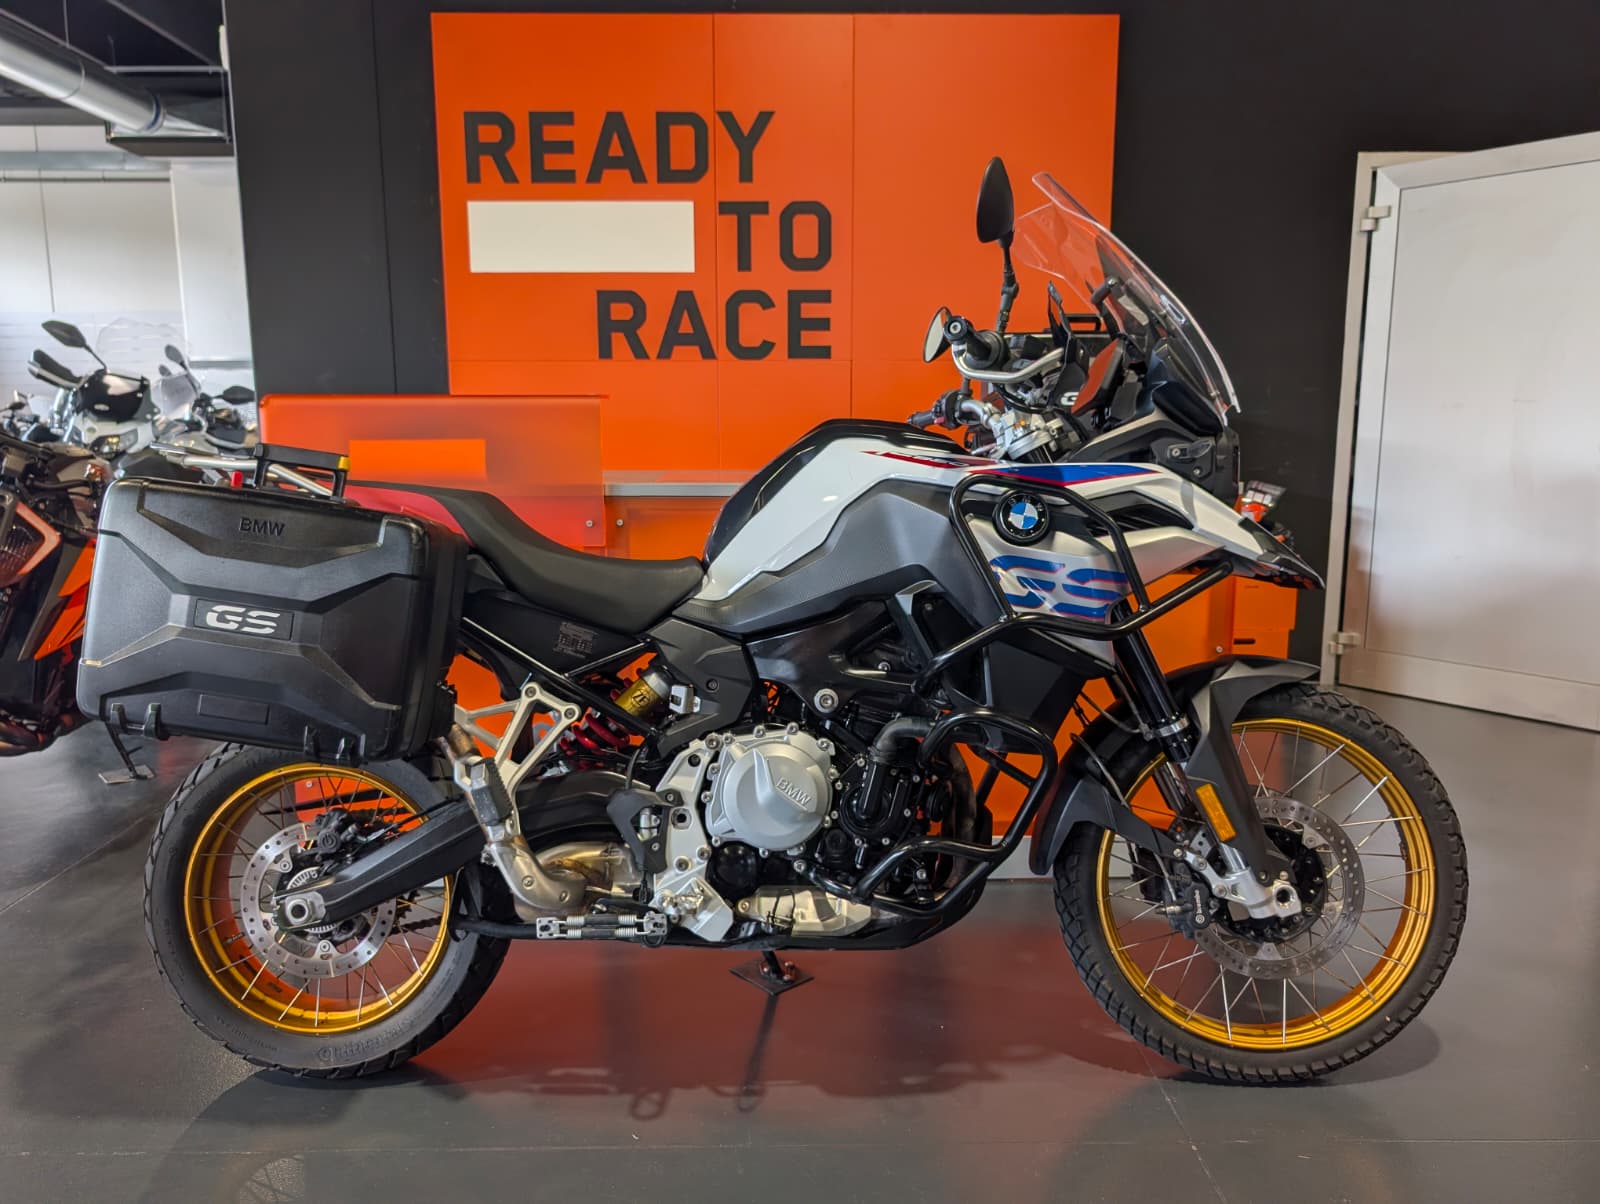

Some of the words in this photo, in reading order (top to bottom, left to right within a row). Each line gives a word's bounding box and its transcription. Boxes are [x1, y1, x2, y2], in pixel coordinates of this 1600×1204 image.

[463, 111, 775, 183] READY
[718, 200, 832, 272] TO
[596, 289, 832, 360] RACE
[239, 517, 285, 536] BMW
[206, 605, 281, 634] GS
[990, 555, 1128, 621] GS
[775, 777, 811, 804] BMW
